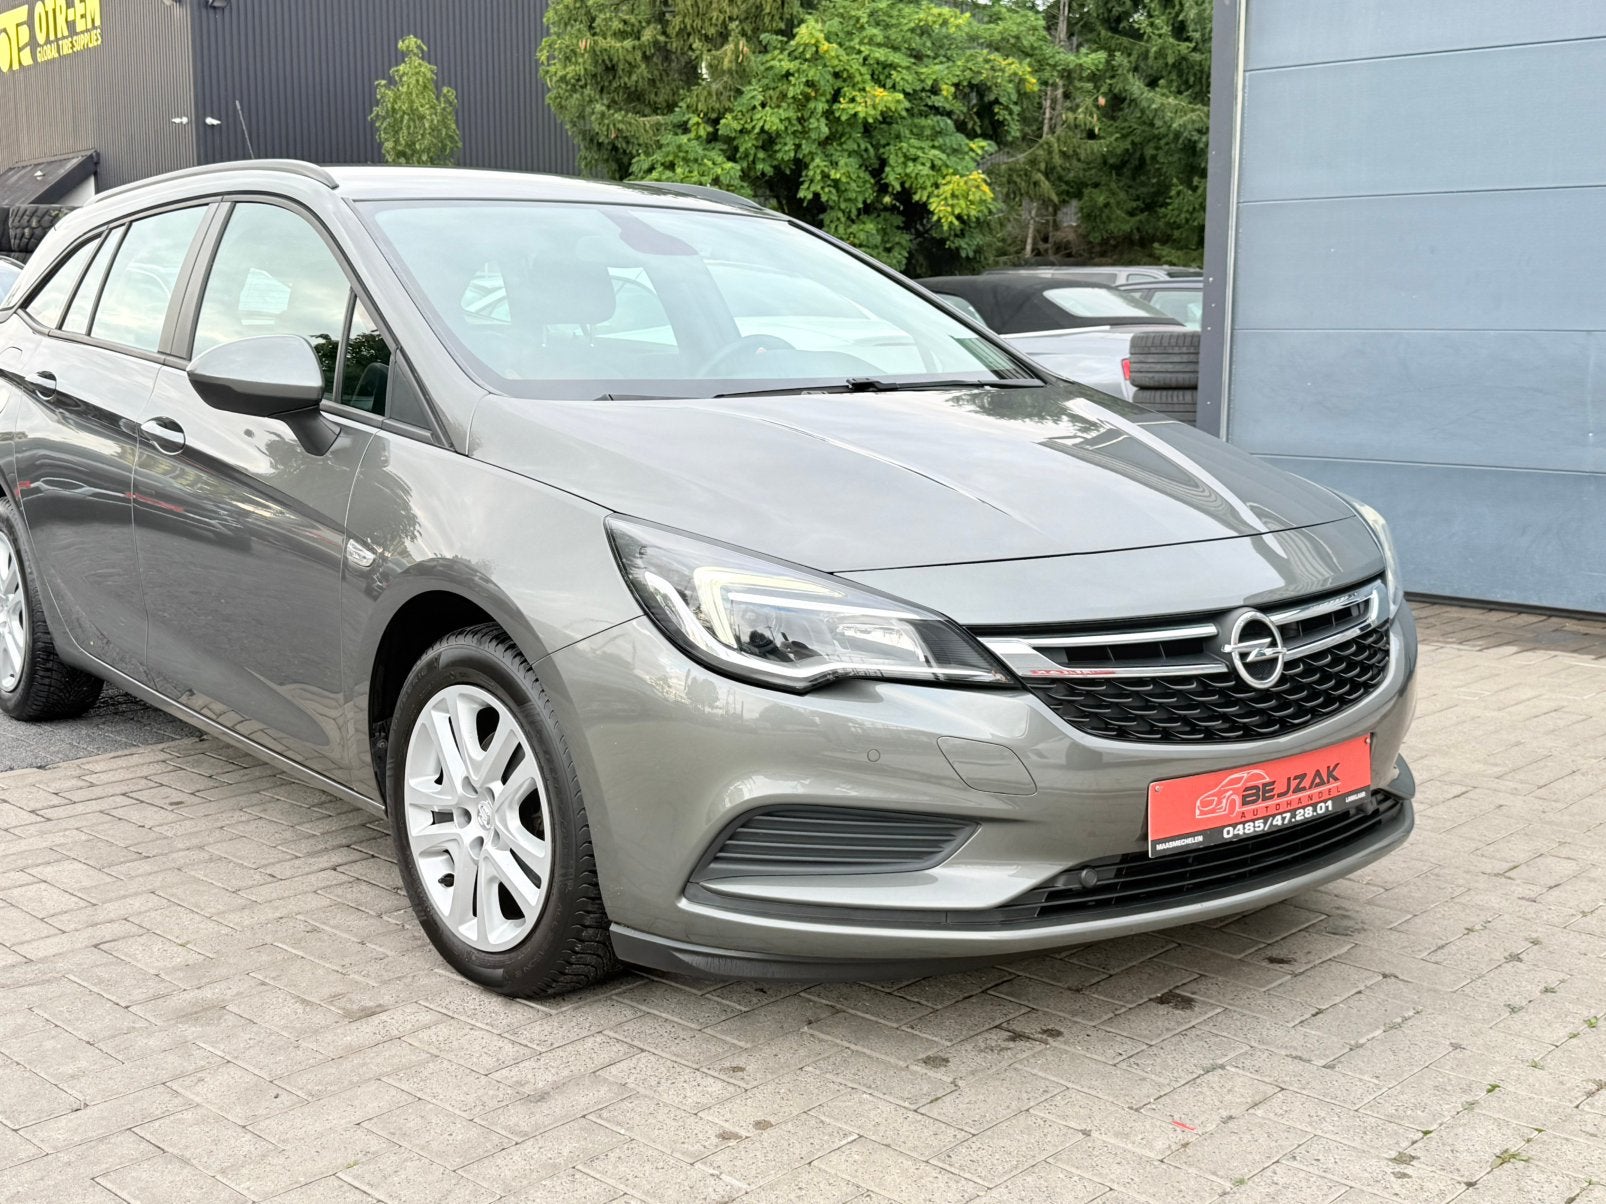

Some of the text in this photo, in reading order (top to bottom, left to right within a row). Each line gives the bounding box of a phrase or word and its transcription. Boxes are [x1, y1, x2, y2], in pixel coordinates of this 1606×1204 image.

[34, 0, 101, 45] OTR-EM
[36, 28, 102, 63] GLOBAL TIRE SUPPLIES
[1241, 762, 1341, 807] BEJZAK
[1222, 799, 1334, 839] 0485/47.28.01
[1240, 787, 1341, 820] AUTOHANDEL
[1155, 834, 1204, 851] MAASMECHELEN
